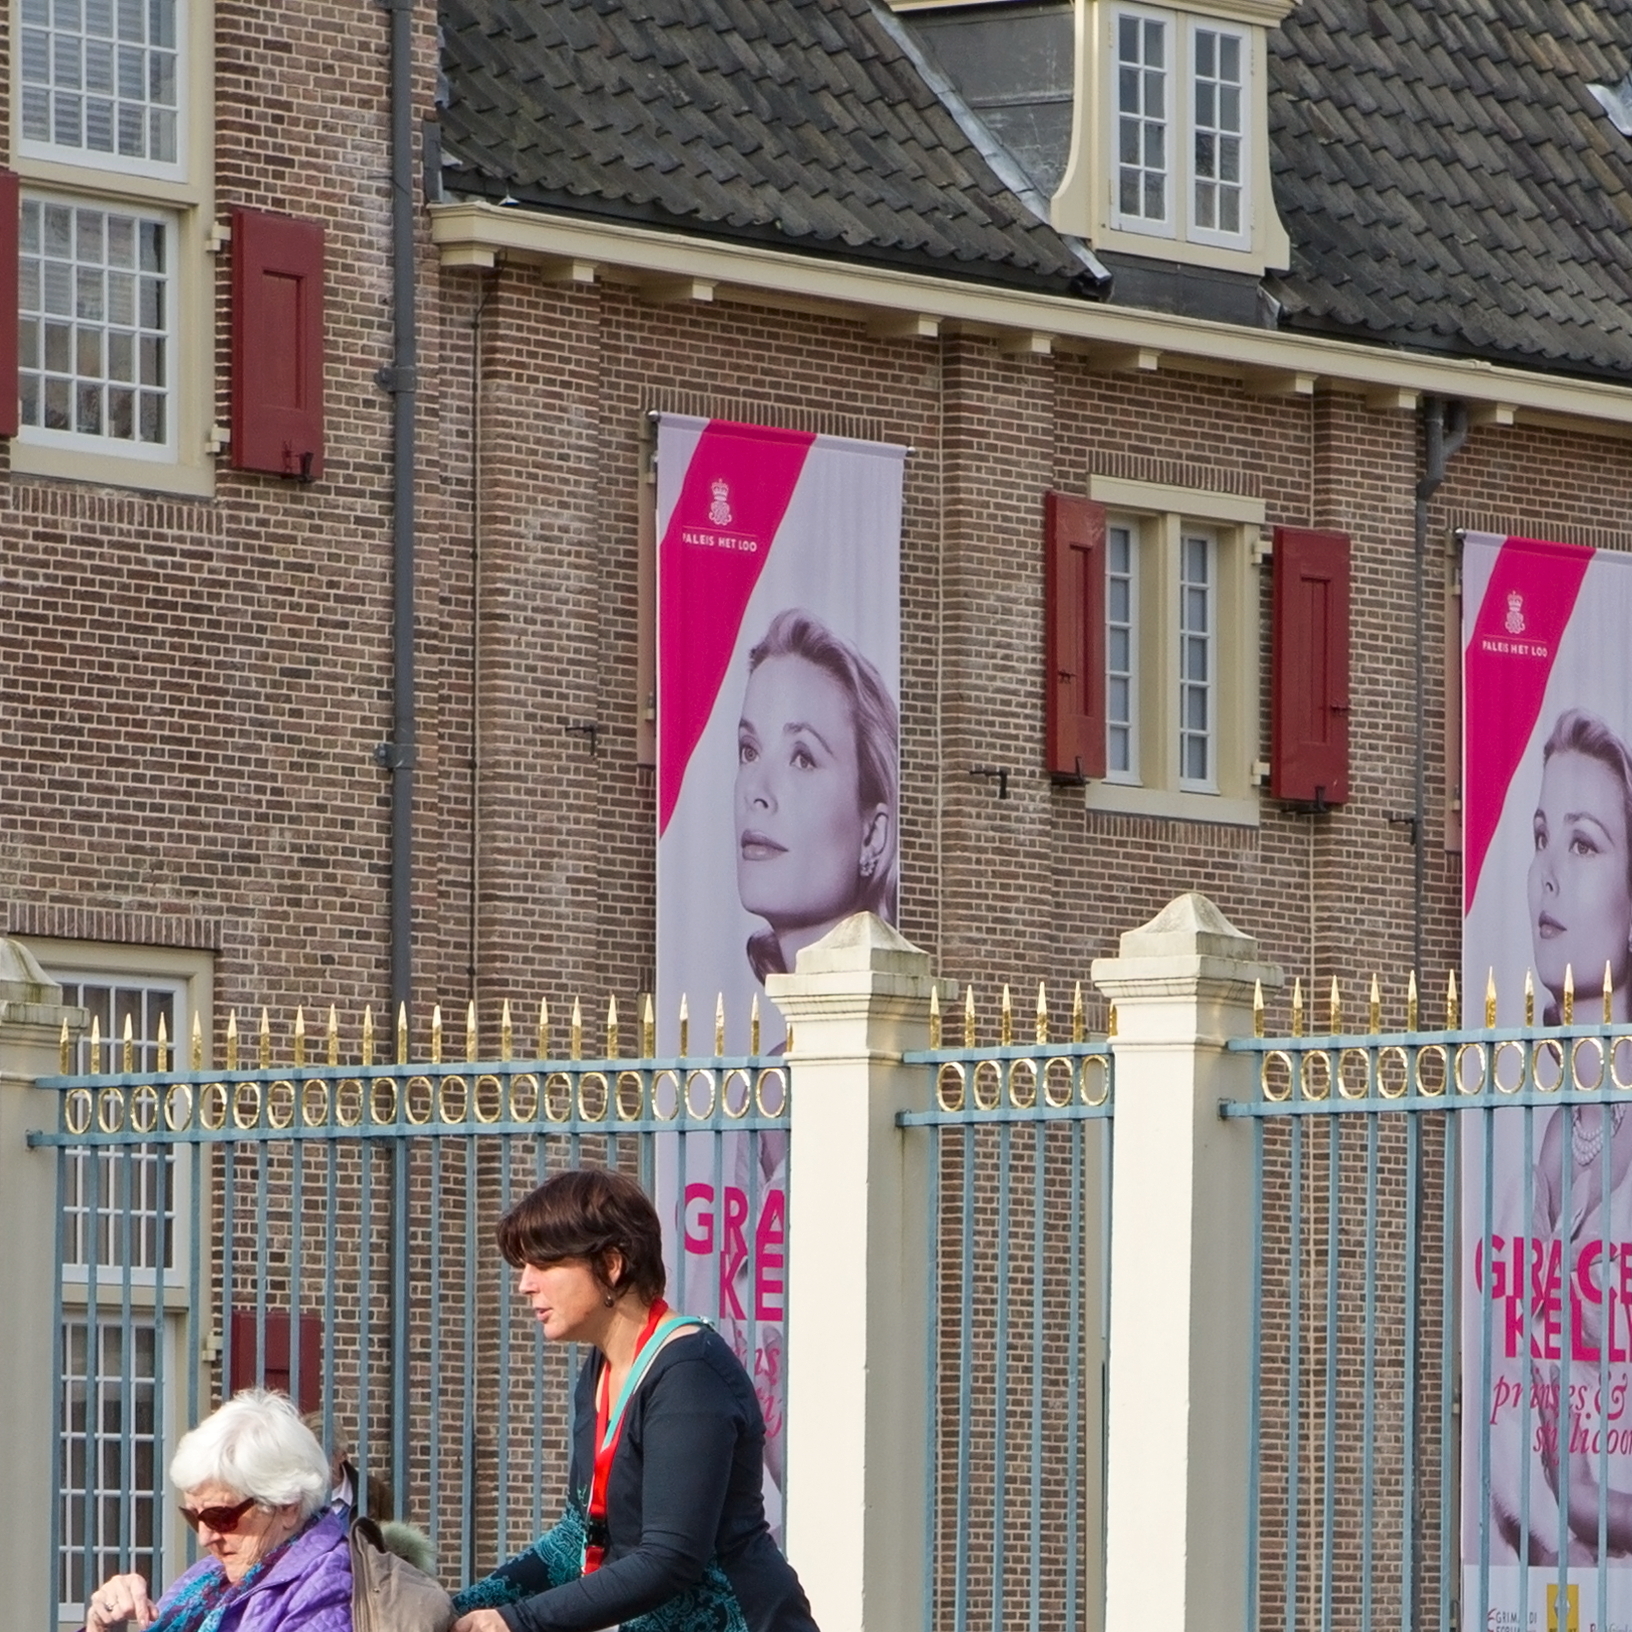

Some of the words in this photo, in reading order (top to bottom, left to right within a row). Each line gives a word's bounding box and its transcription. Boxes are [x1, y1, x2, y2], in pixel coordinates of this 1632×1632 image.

[718, 537, 736, 549] HET
[738, 540, 757, 552] LOO
[1510, 644, 1529, 655] HET
[675, 1182, 785, 1257] GRA
[719, 1250, 784, 1322] KE
[1489, 1367, 1588, 1426] prinses
[1594, 1370, 1628, 1421] &
[1495, 1612, 1537, 1624] GRIMDI
